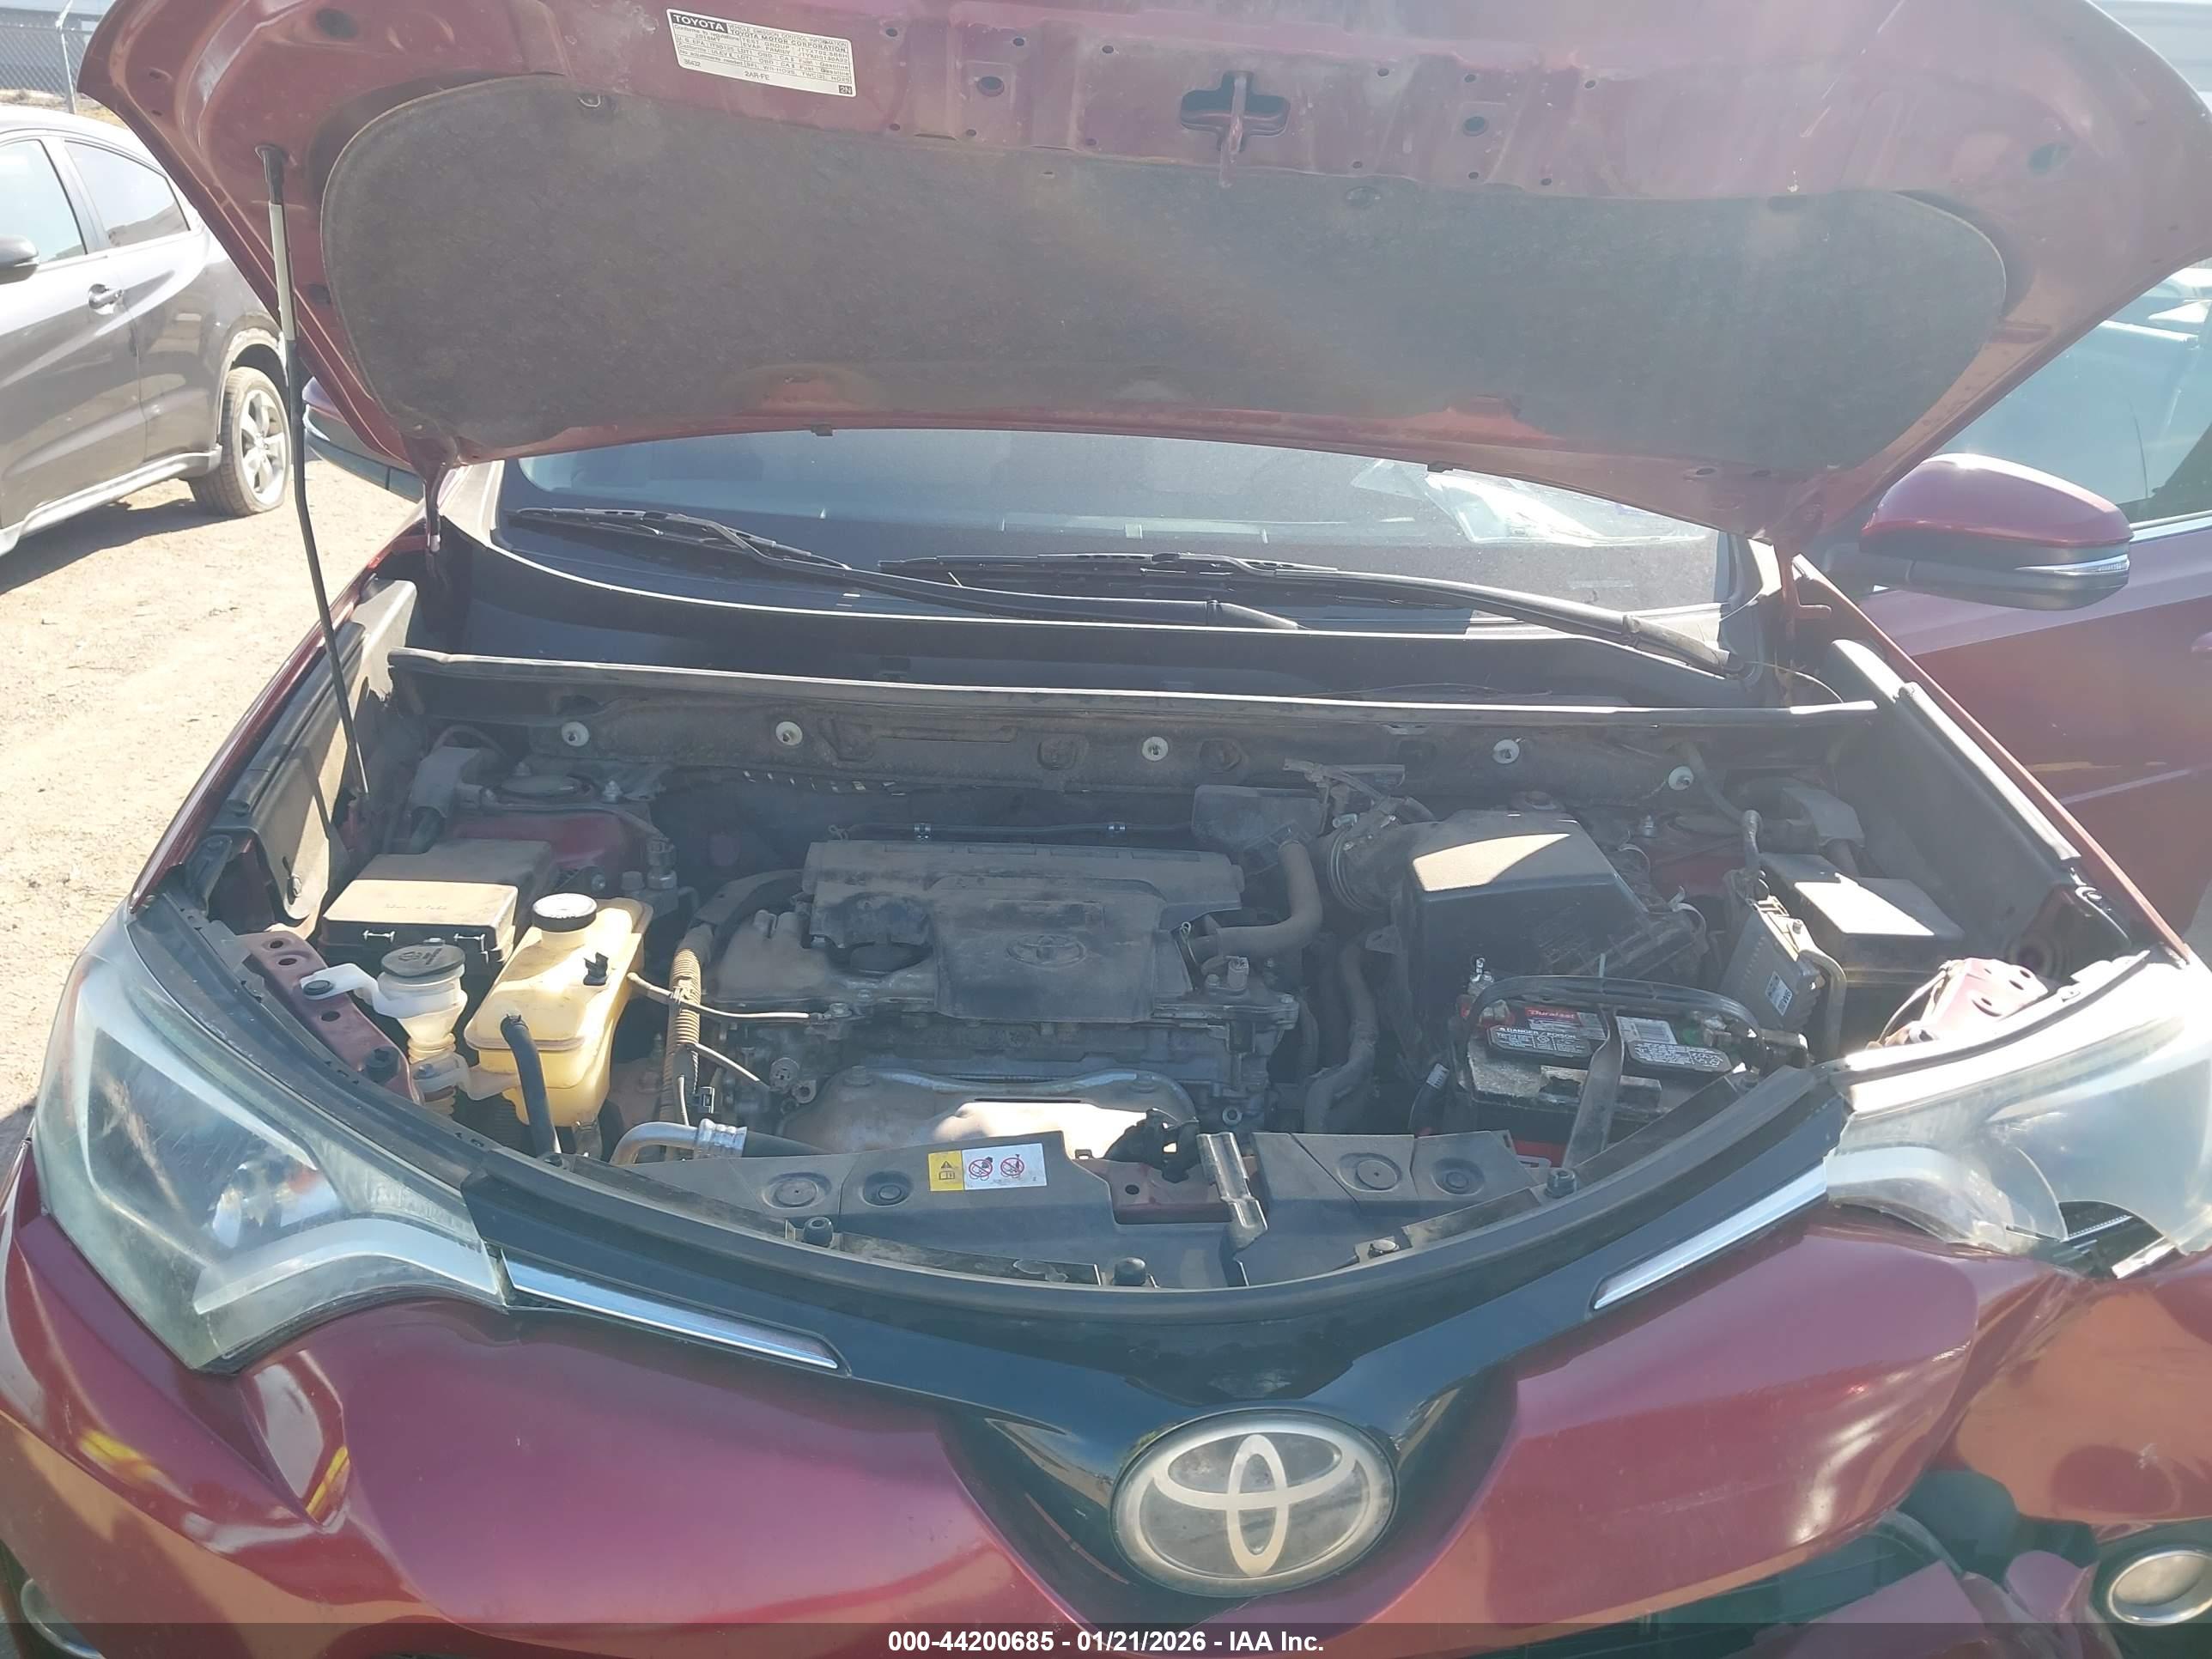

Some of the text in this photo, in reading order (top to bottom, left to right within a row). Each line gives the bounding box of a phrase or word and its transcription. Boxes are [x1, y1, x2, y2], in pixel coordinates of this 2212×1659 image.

[672, 15, 724, 31] TOYOTA
[730, 29, 845, 52] TOYOTA MOTOR CORPORATION
[744, 70, 769, 80] 2AR-FE
[1529, 1010, 1574, 1018] Duralast
